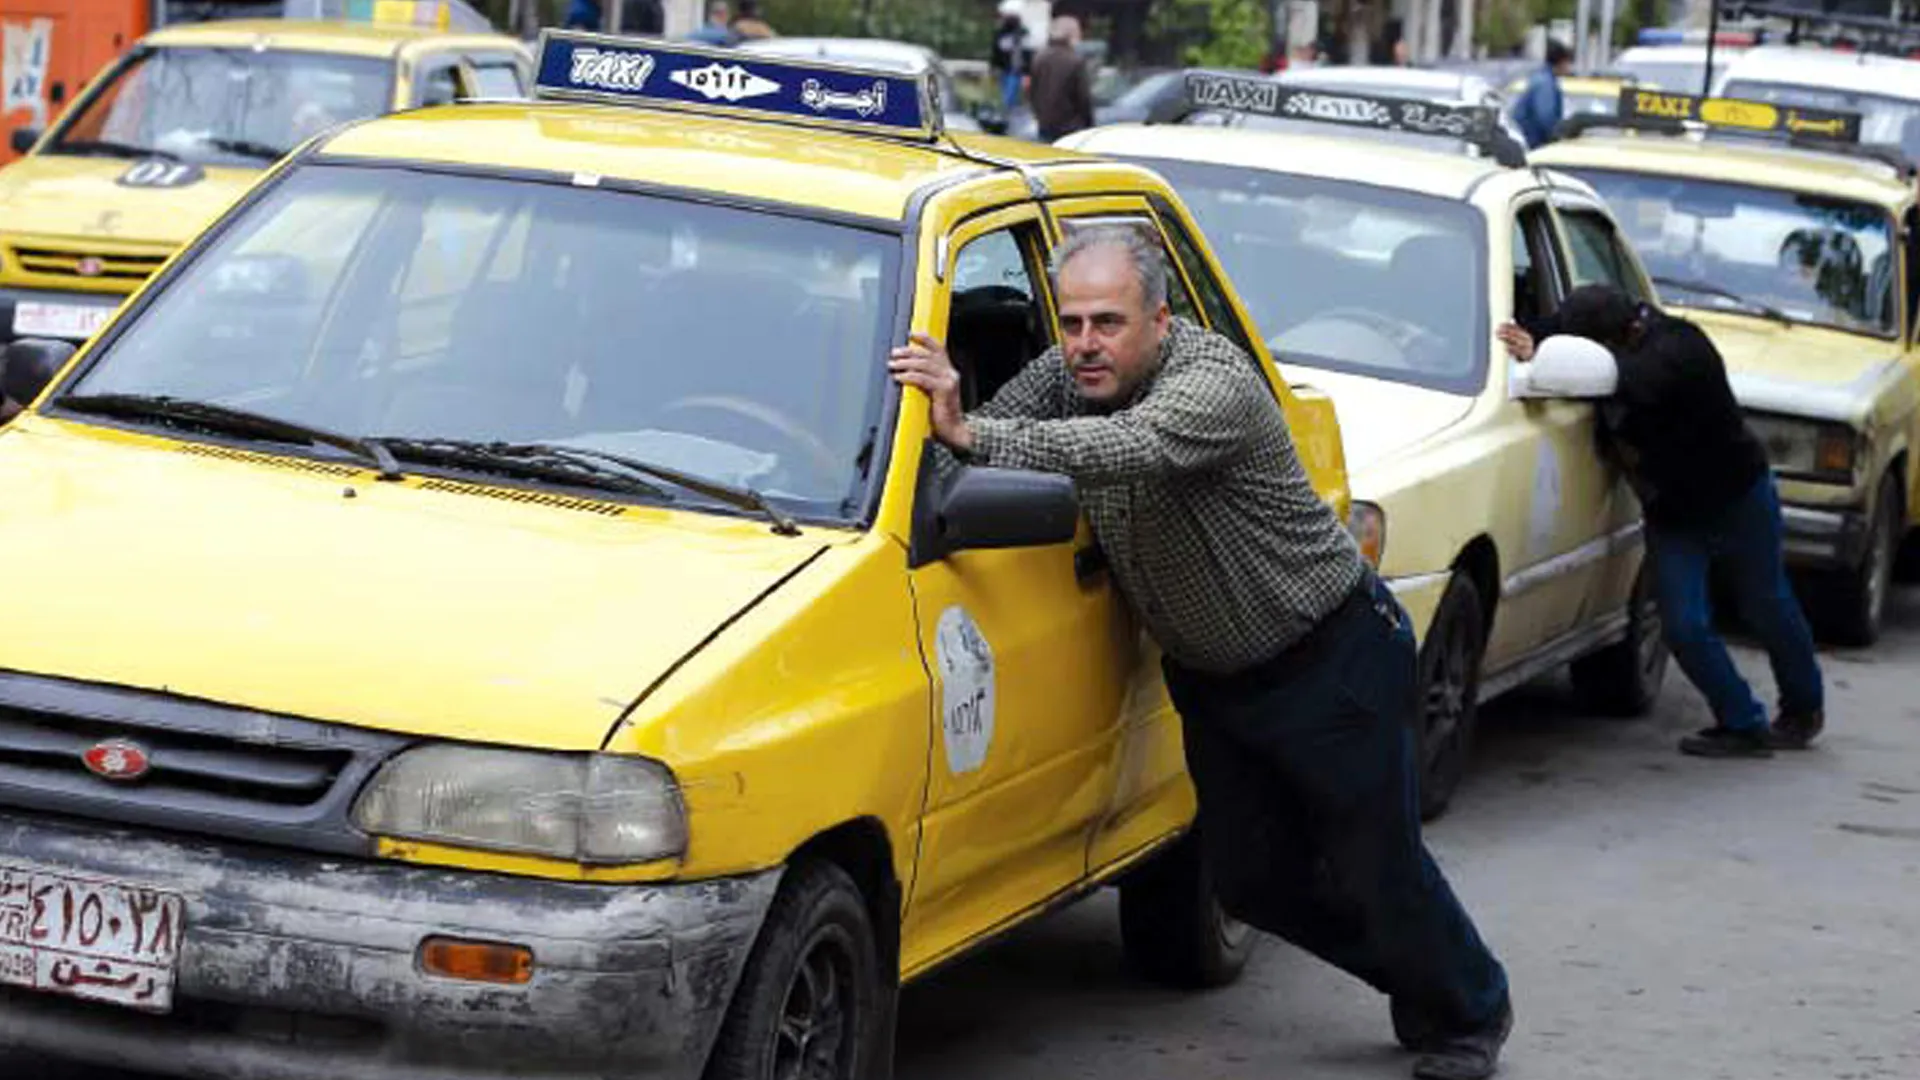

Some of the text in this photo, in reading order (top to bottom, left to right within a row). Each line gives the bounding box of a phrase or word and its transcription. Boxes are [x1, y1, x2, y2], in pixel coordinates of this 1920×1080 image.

[571, 48, 656, 89] TAXI
[1187, 75, 1279, 112] TAXI
[1636, 92, 1692, 117] TAXI
[125, 161, 191, 186] 01
